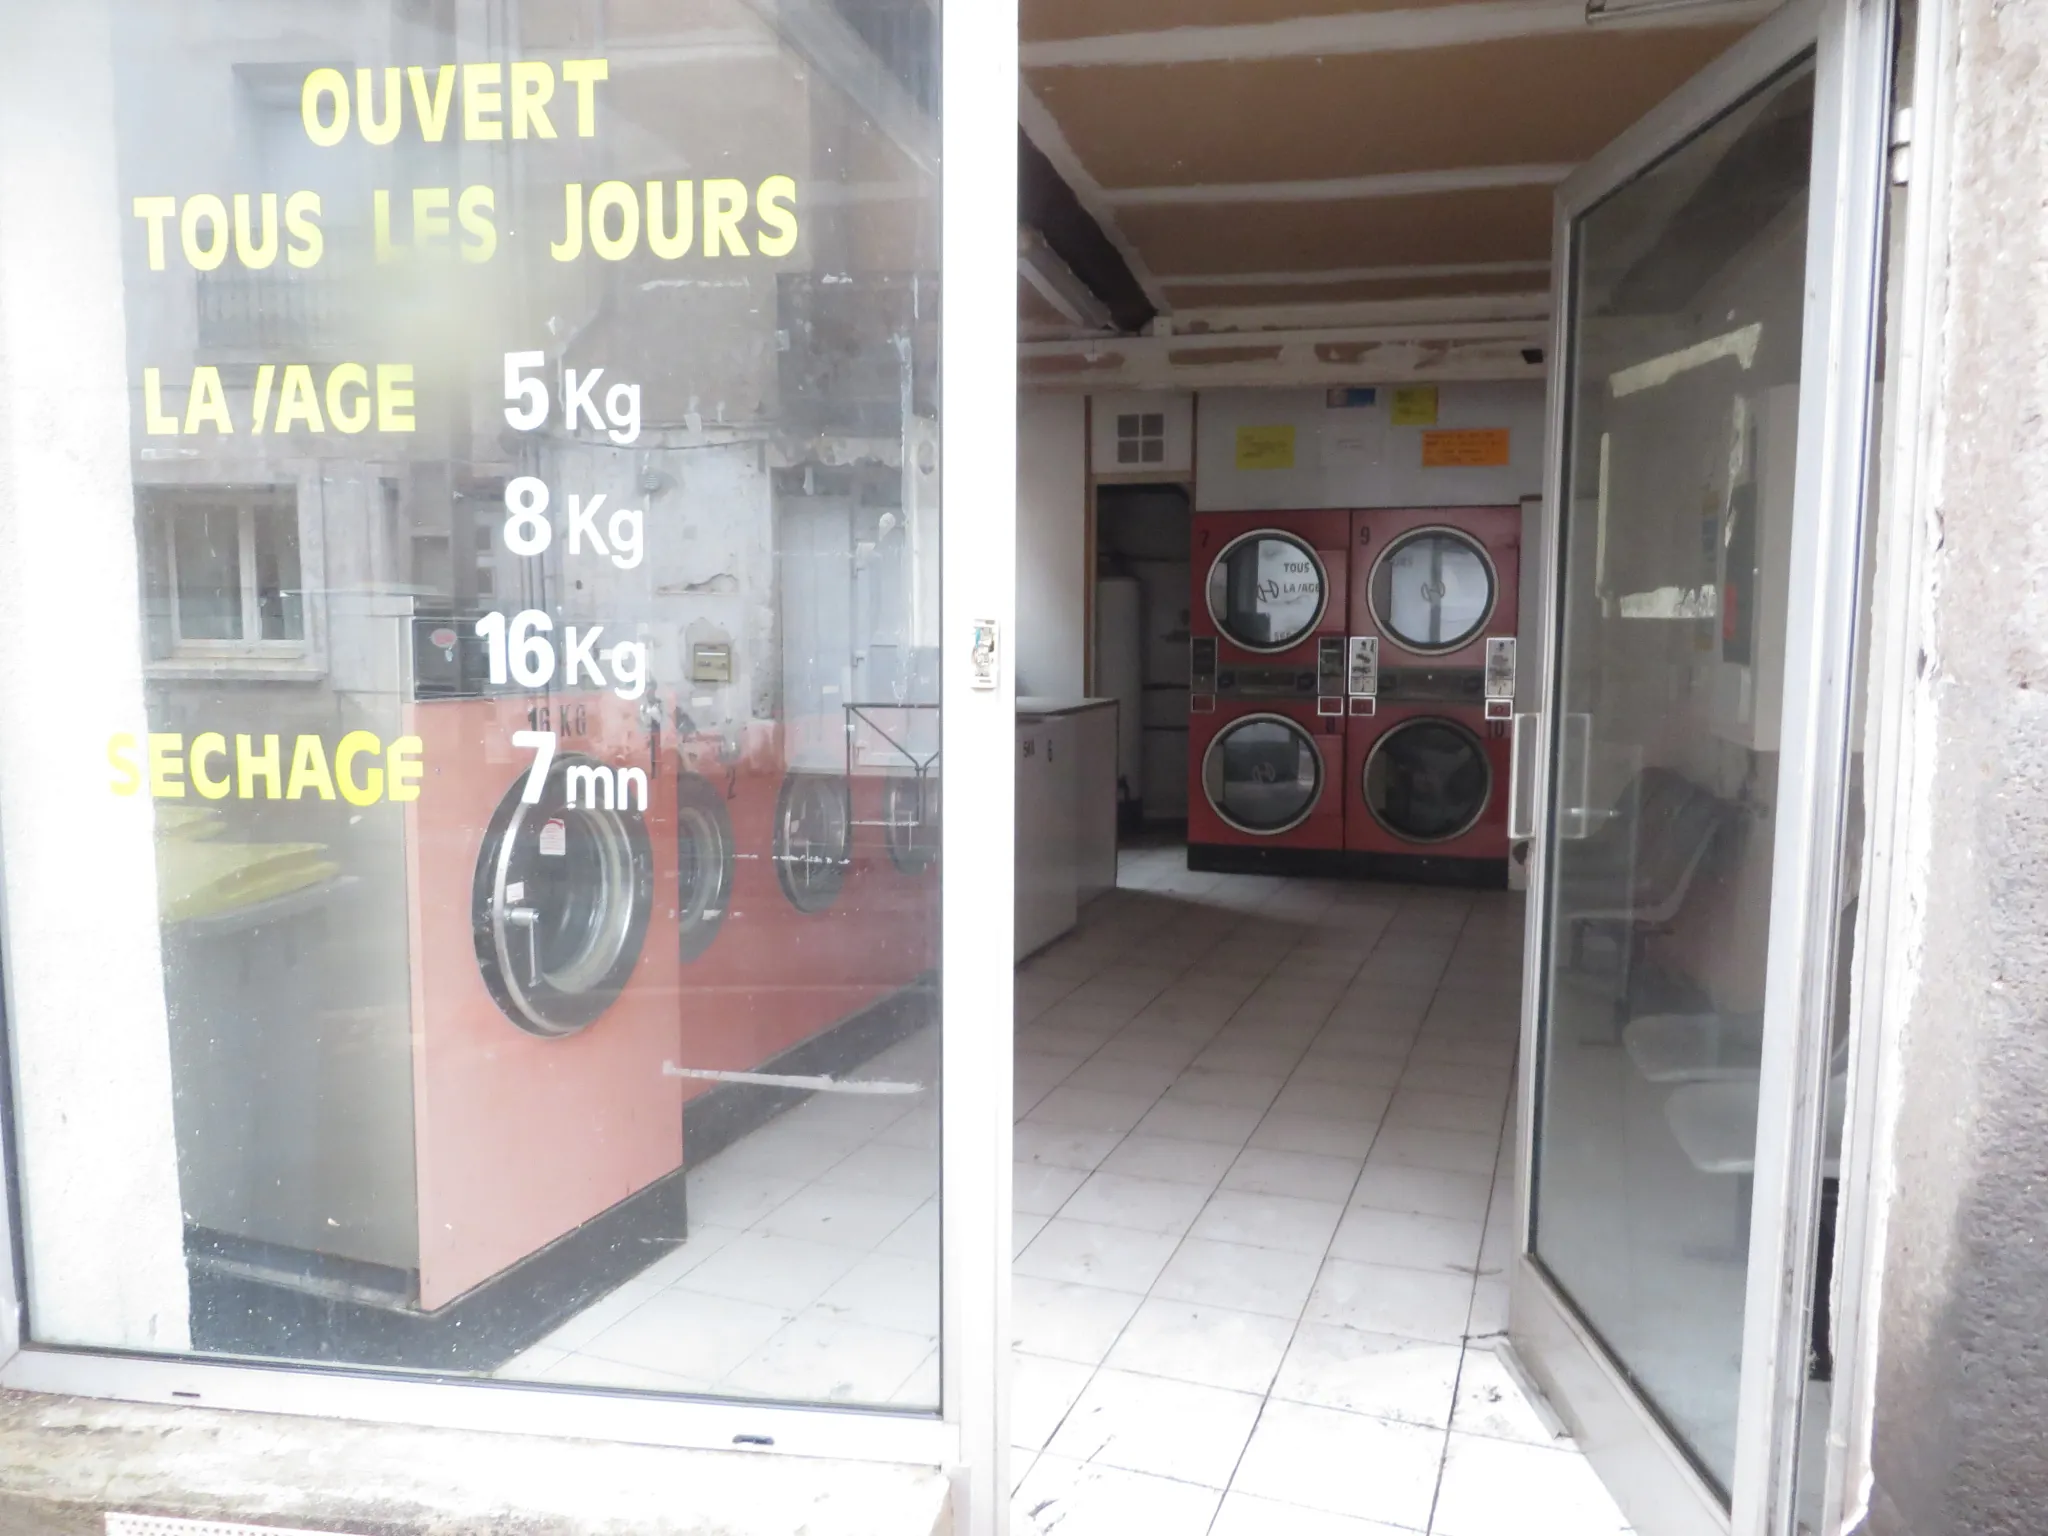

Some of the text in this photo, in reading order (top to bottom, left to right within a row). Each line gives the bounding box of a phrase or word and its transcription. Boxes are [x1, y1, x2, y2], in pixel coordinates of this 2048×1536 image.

[302, 58, 608, 147] OUVERT
[133, 175, 798, 271] TOUS LES JOURS
[503, 350, 548, 431] 5
[564, 368, 641, 444] Kg
[503, 476, 645, 570] 8 Kg
[1283, 562, 1310, 573] TOUS
[1360, 526, 1370, 545] 9
[475, 609, 647, 701] 16 Kg
[559, 704, 587, 737] KG
[107, 730, 649, 811] SECHAGE 7 mn
